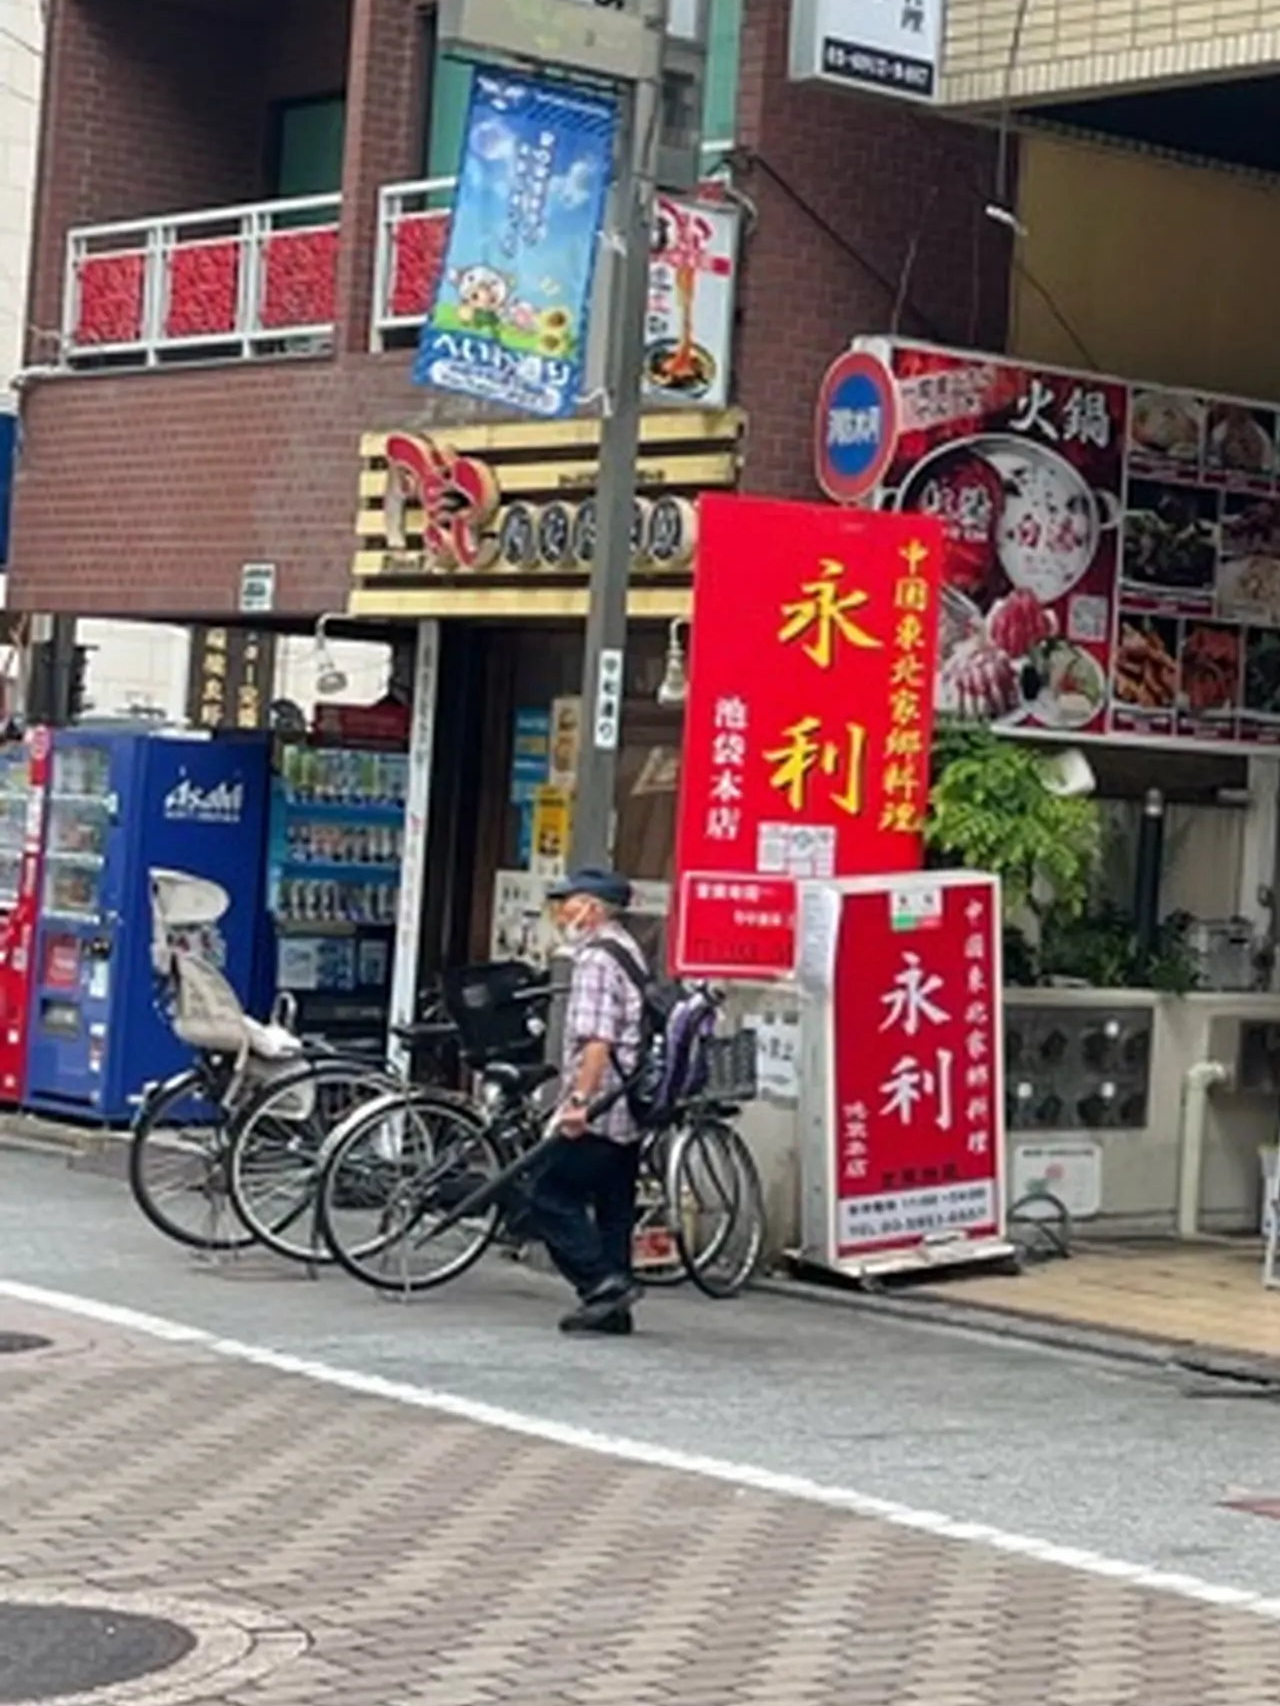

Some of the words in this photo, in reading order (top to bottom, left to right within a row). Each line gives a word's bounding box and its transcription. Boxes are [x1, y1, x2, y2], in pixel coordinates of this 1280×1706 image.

[1010, 379, 1111, 448] 火鍋
[761, 557, 884, 815] 永利
[164, 777, 244, 810] Asahi
[704, 696, 748, 840] 池袋本店
[877, 950, 954, 1132] 永利
[842, 1099, 869, 1178] 池袋本店
